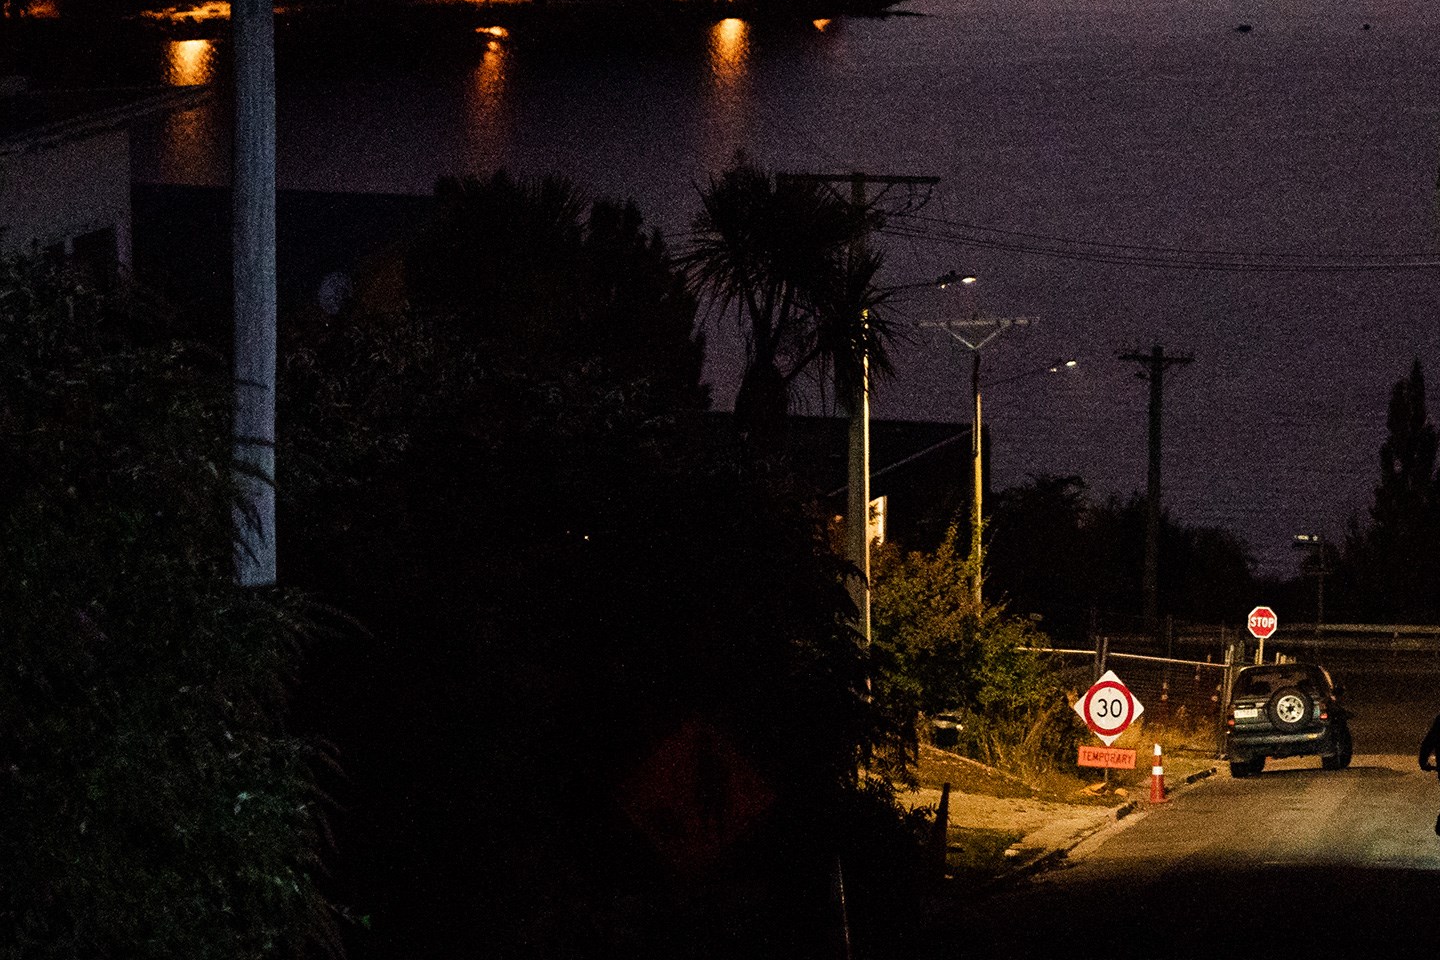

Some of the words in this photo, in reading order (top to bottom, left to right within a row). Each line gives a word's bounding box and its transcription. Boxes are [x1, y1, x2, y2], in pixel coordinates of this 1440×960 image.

[1250, 616, 1274, 628] STOP
[1096, 698, 1122, 718] 30
[1082, 750, 1133, 765] TEMPORARY
